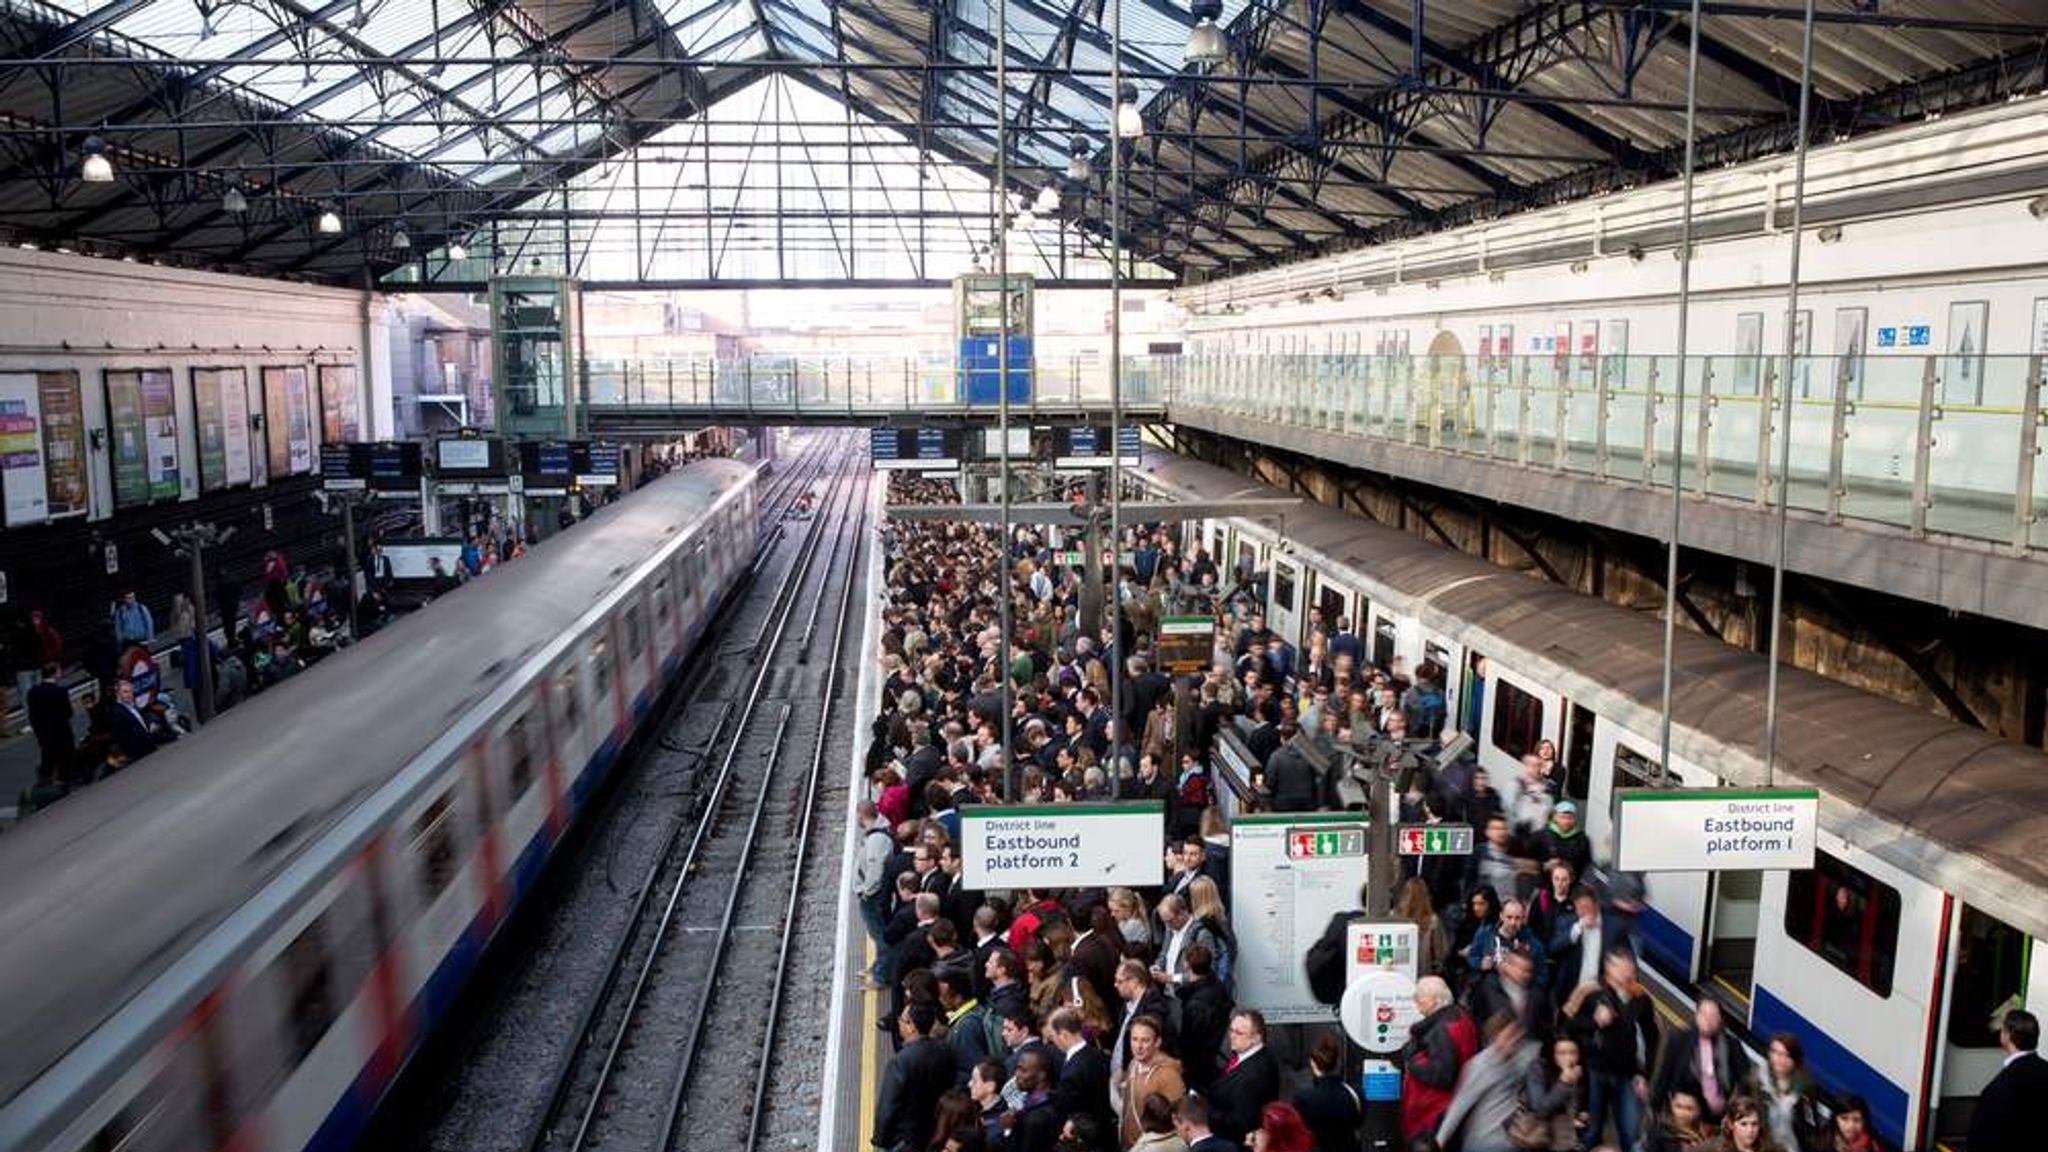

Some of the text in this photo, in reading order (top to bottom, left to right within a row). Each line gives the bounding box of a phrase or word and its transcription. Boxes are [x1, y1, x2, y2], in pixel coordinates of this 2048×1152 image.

[1728, 802, 1795, 815] District line
[985, 819, 1056, 832] District line
[1704, 818, 1795, 833] Eastbound
[986, 835, 1081, 850] Eastbound
[1706, 836, 1781, 854] platform
[986, 853, 1080, 872] platform 2
